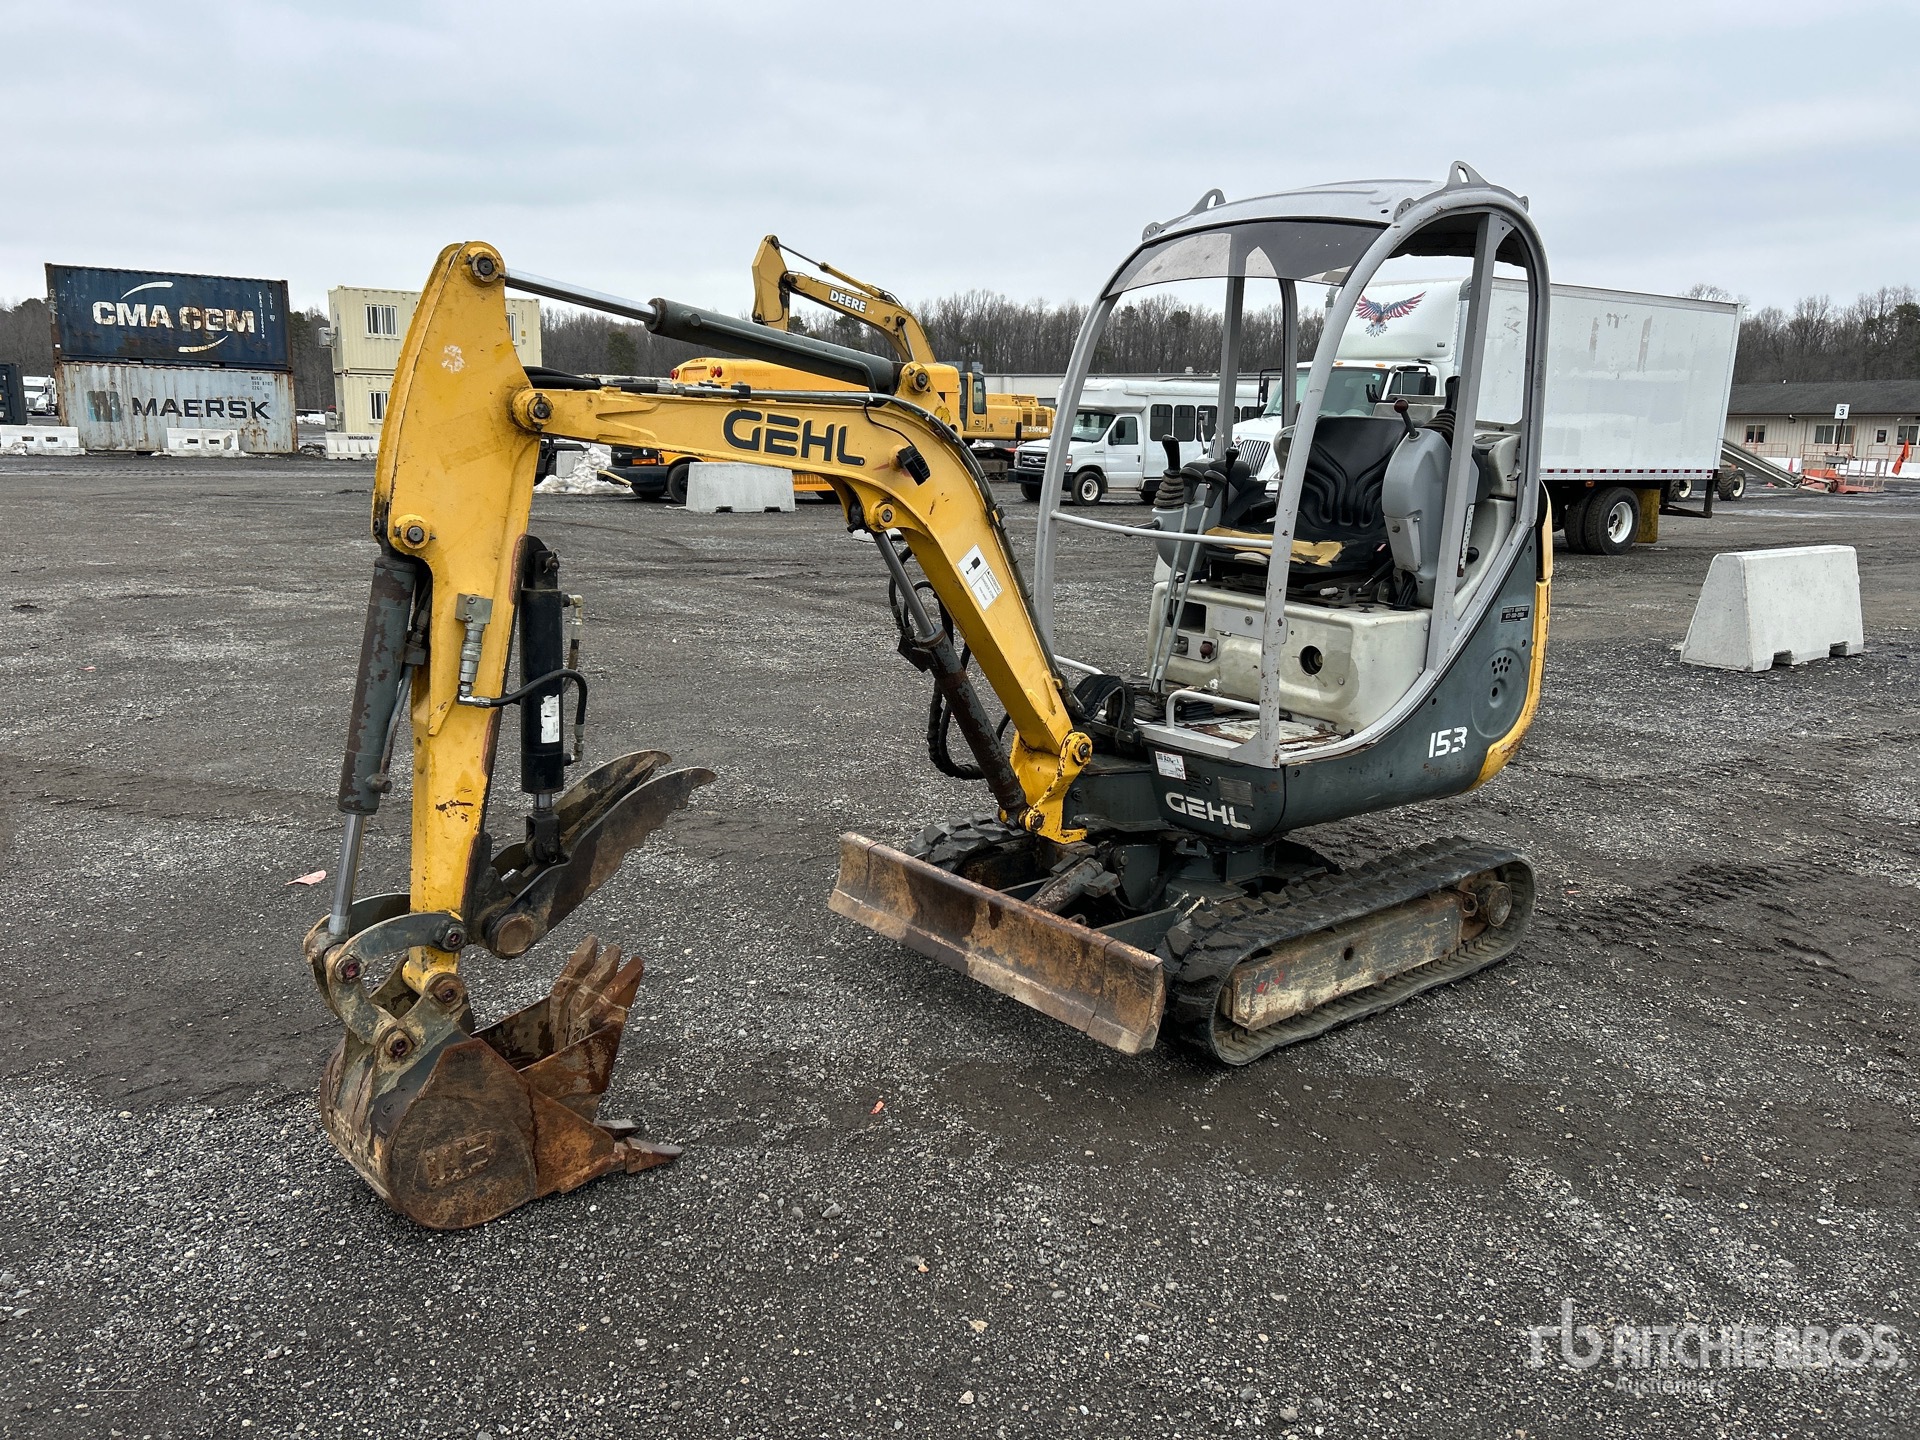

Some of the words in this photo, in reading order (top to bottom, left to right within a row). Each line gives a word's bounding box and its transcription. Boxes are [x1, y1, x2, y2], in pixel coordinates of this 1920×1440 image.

[92, 301, 174, 329] CMA
[178, 306, 255, 334] CGM
[830, 289, 866, 313] DEERE
[132, 397, 270, 420] MAERSK
[723, 408, 866, 466] GEHL
[1428, 726, 1468, 759] 153
[1165, 791, 1251, 830] GEHL
